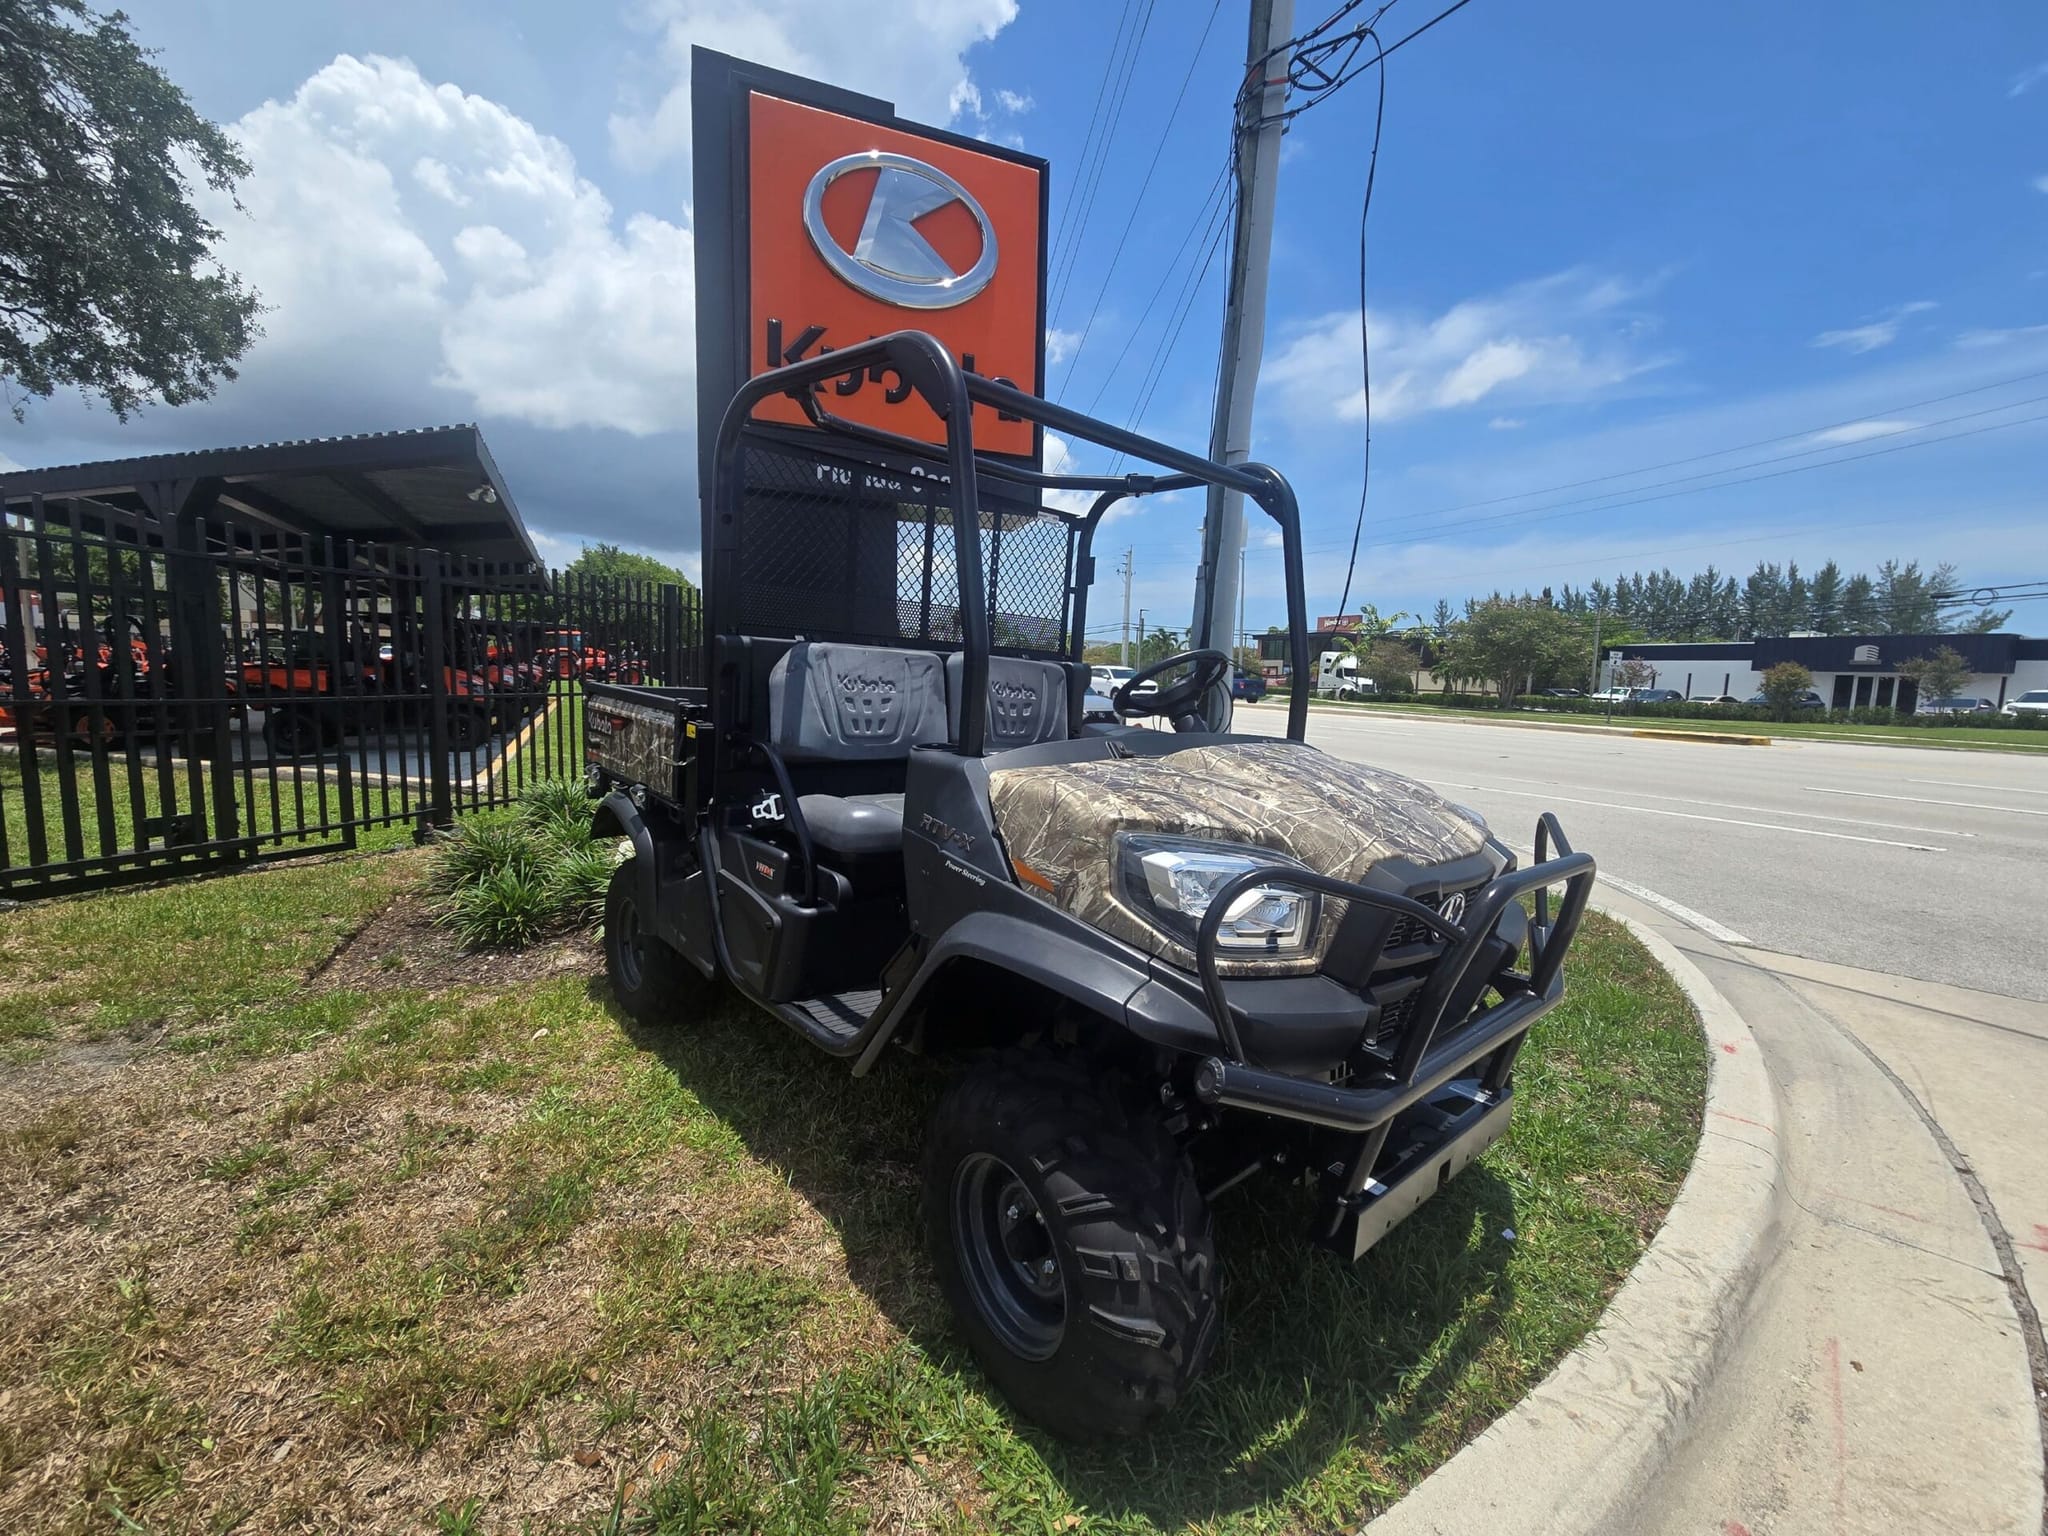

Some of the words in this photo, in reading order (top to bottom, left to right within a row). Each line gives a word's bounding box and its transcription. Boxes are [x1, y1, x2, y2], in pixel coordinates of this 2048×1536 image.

[766, 317, 1023, 423] Kubt
[837, 673, 897, 694] Kubota
[991, 680, 1037, 701] Kubota
[920, 812, 976, 852] RTV-X
[945, 860, 962, 873] Power
[961, 868, 986, 887] Steering
